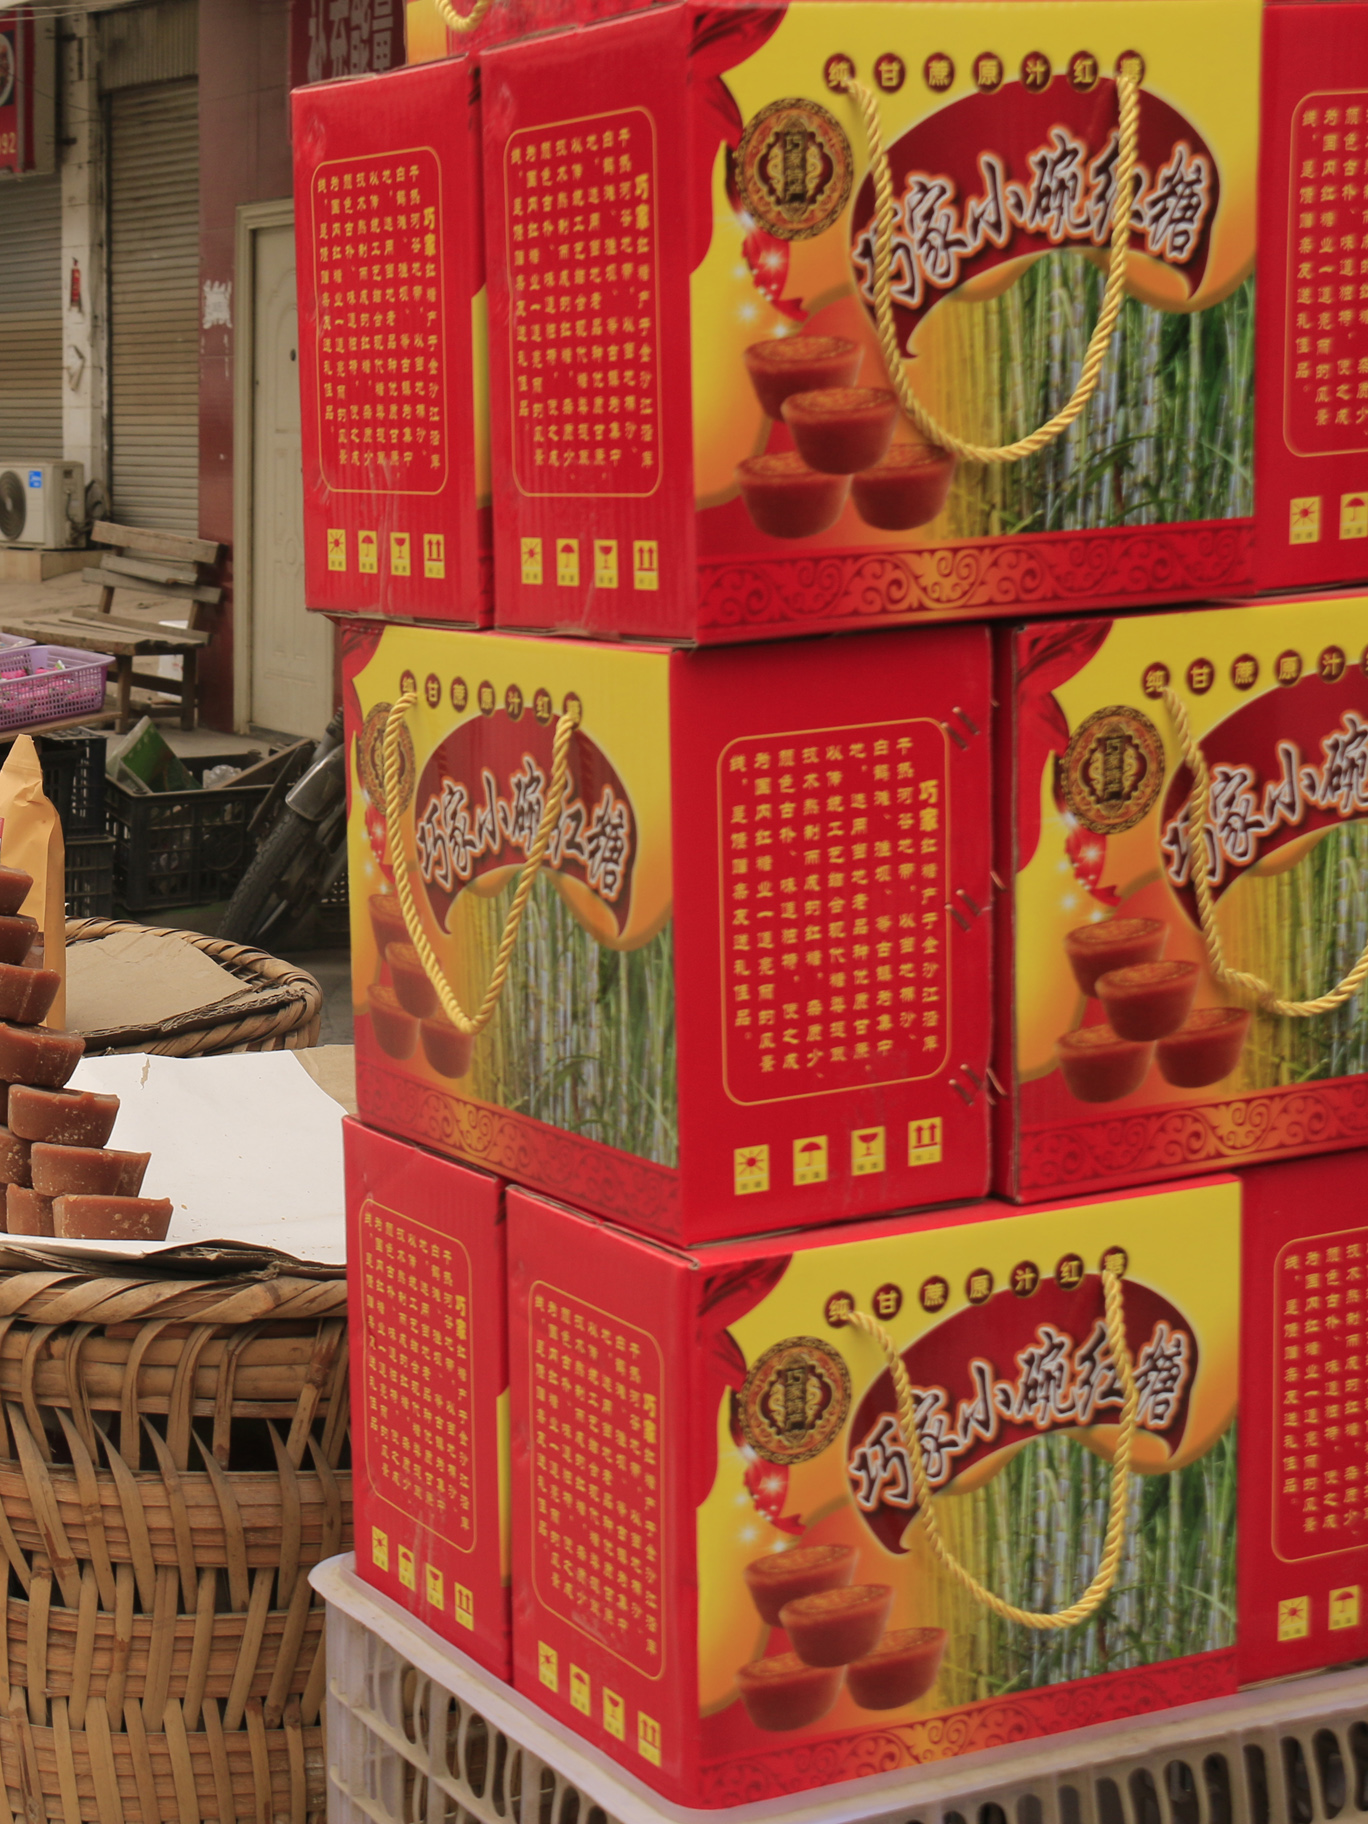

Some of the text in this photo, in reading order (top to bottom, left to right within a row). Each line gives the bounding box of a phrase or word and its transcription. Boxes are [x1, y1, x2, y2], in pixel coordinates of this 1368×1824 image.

[1145, 650, 1368, 694] 纯甘蔗原汁
